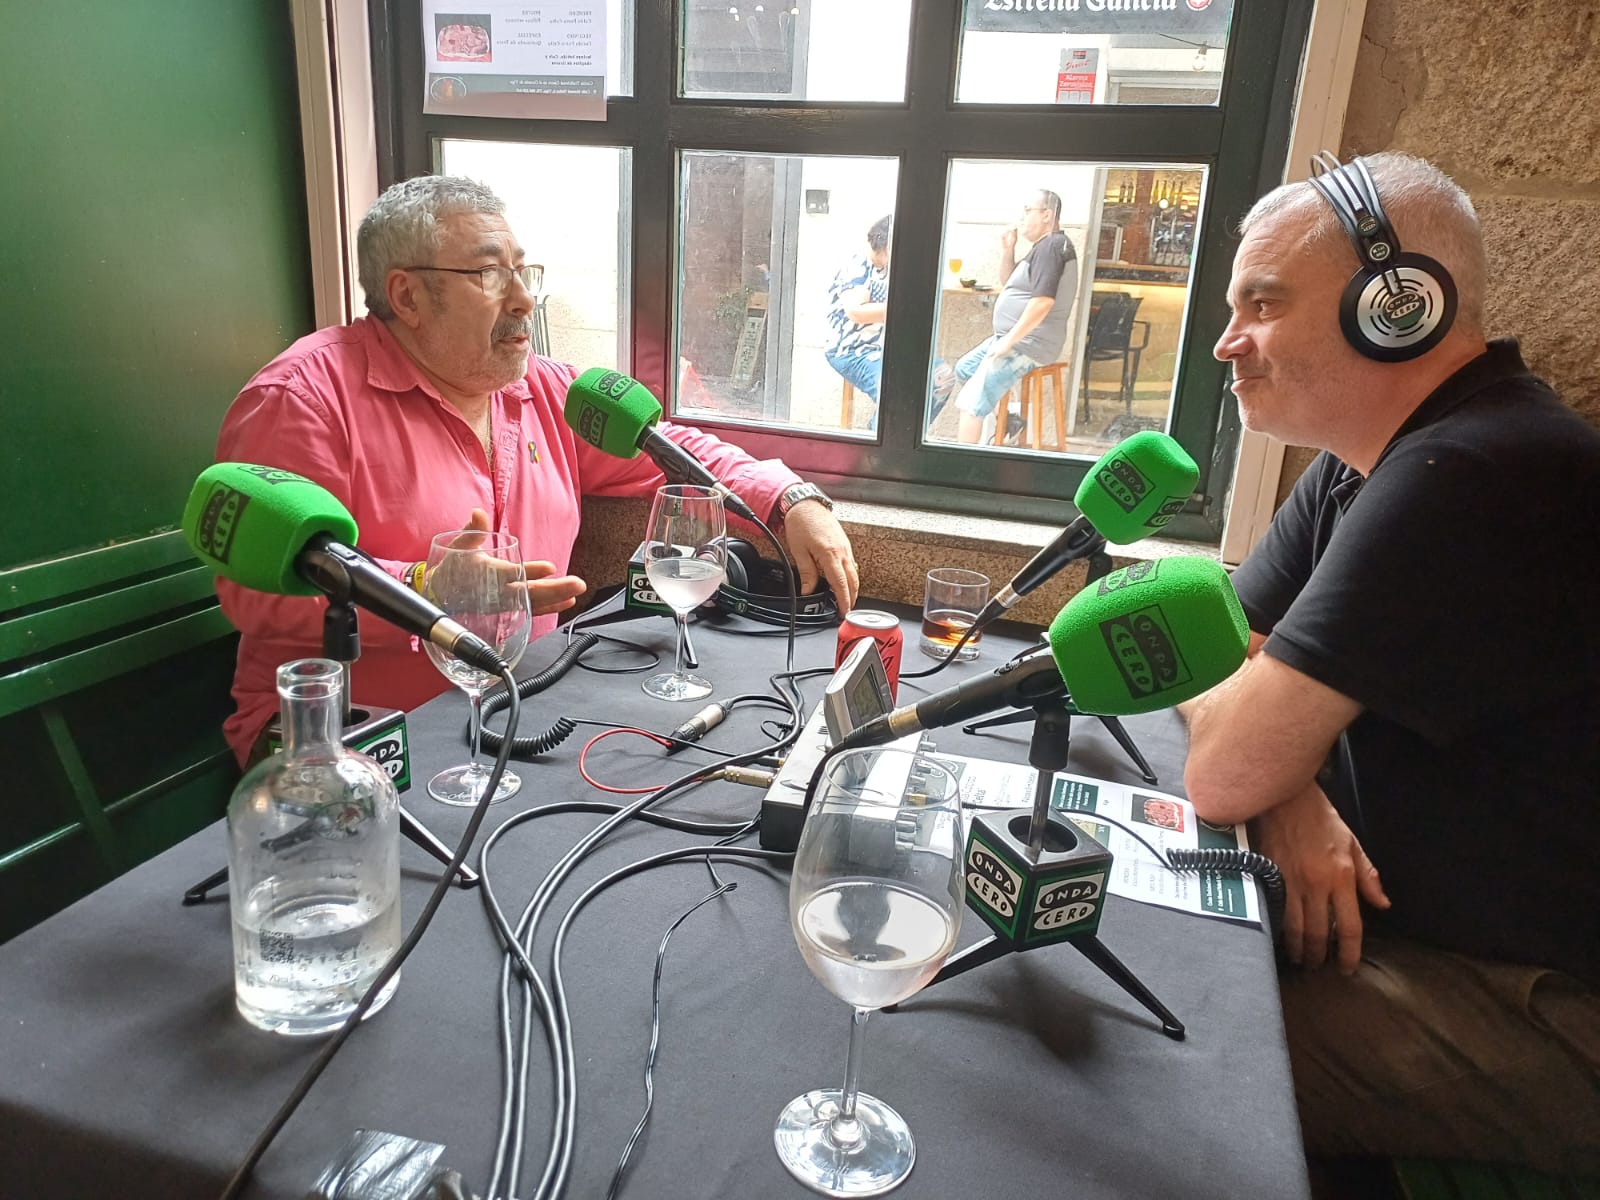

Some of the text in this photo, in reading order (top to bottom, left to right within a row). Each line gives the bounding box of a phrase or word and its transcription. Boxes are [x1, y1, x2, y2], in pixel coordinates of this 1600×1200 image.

[1394, 303, 1417, 317] CERO
[1103, 474, 1132, 503] CERO
[1113, 461, 1142, 492] ONDA
[214, 501, 236, 548] CERO
[1116, 632, 1150, 685] CERO
[1140, 620, 1173, 677] ONDA
[368, 743, 397, 761] NDA
[975, 853, 1013, 892] ONDA
[974, 876, 1008, 912] CERO
[1044, 885, 1093, 905] ONDA
[1043, 906, 1089, 926] CERO
